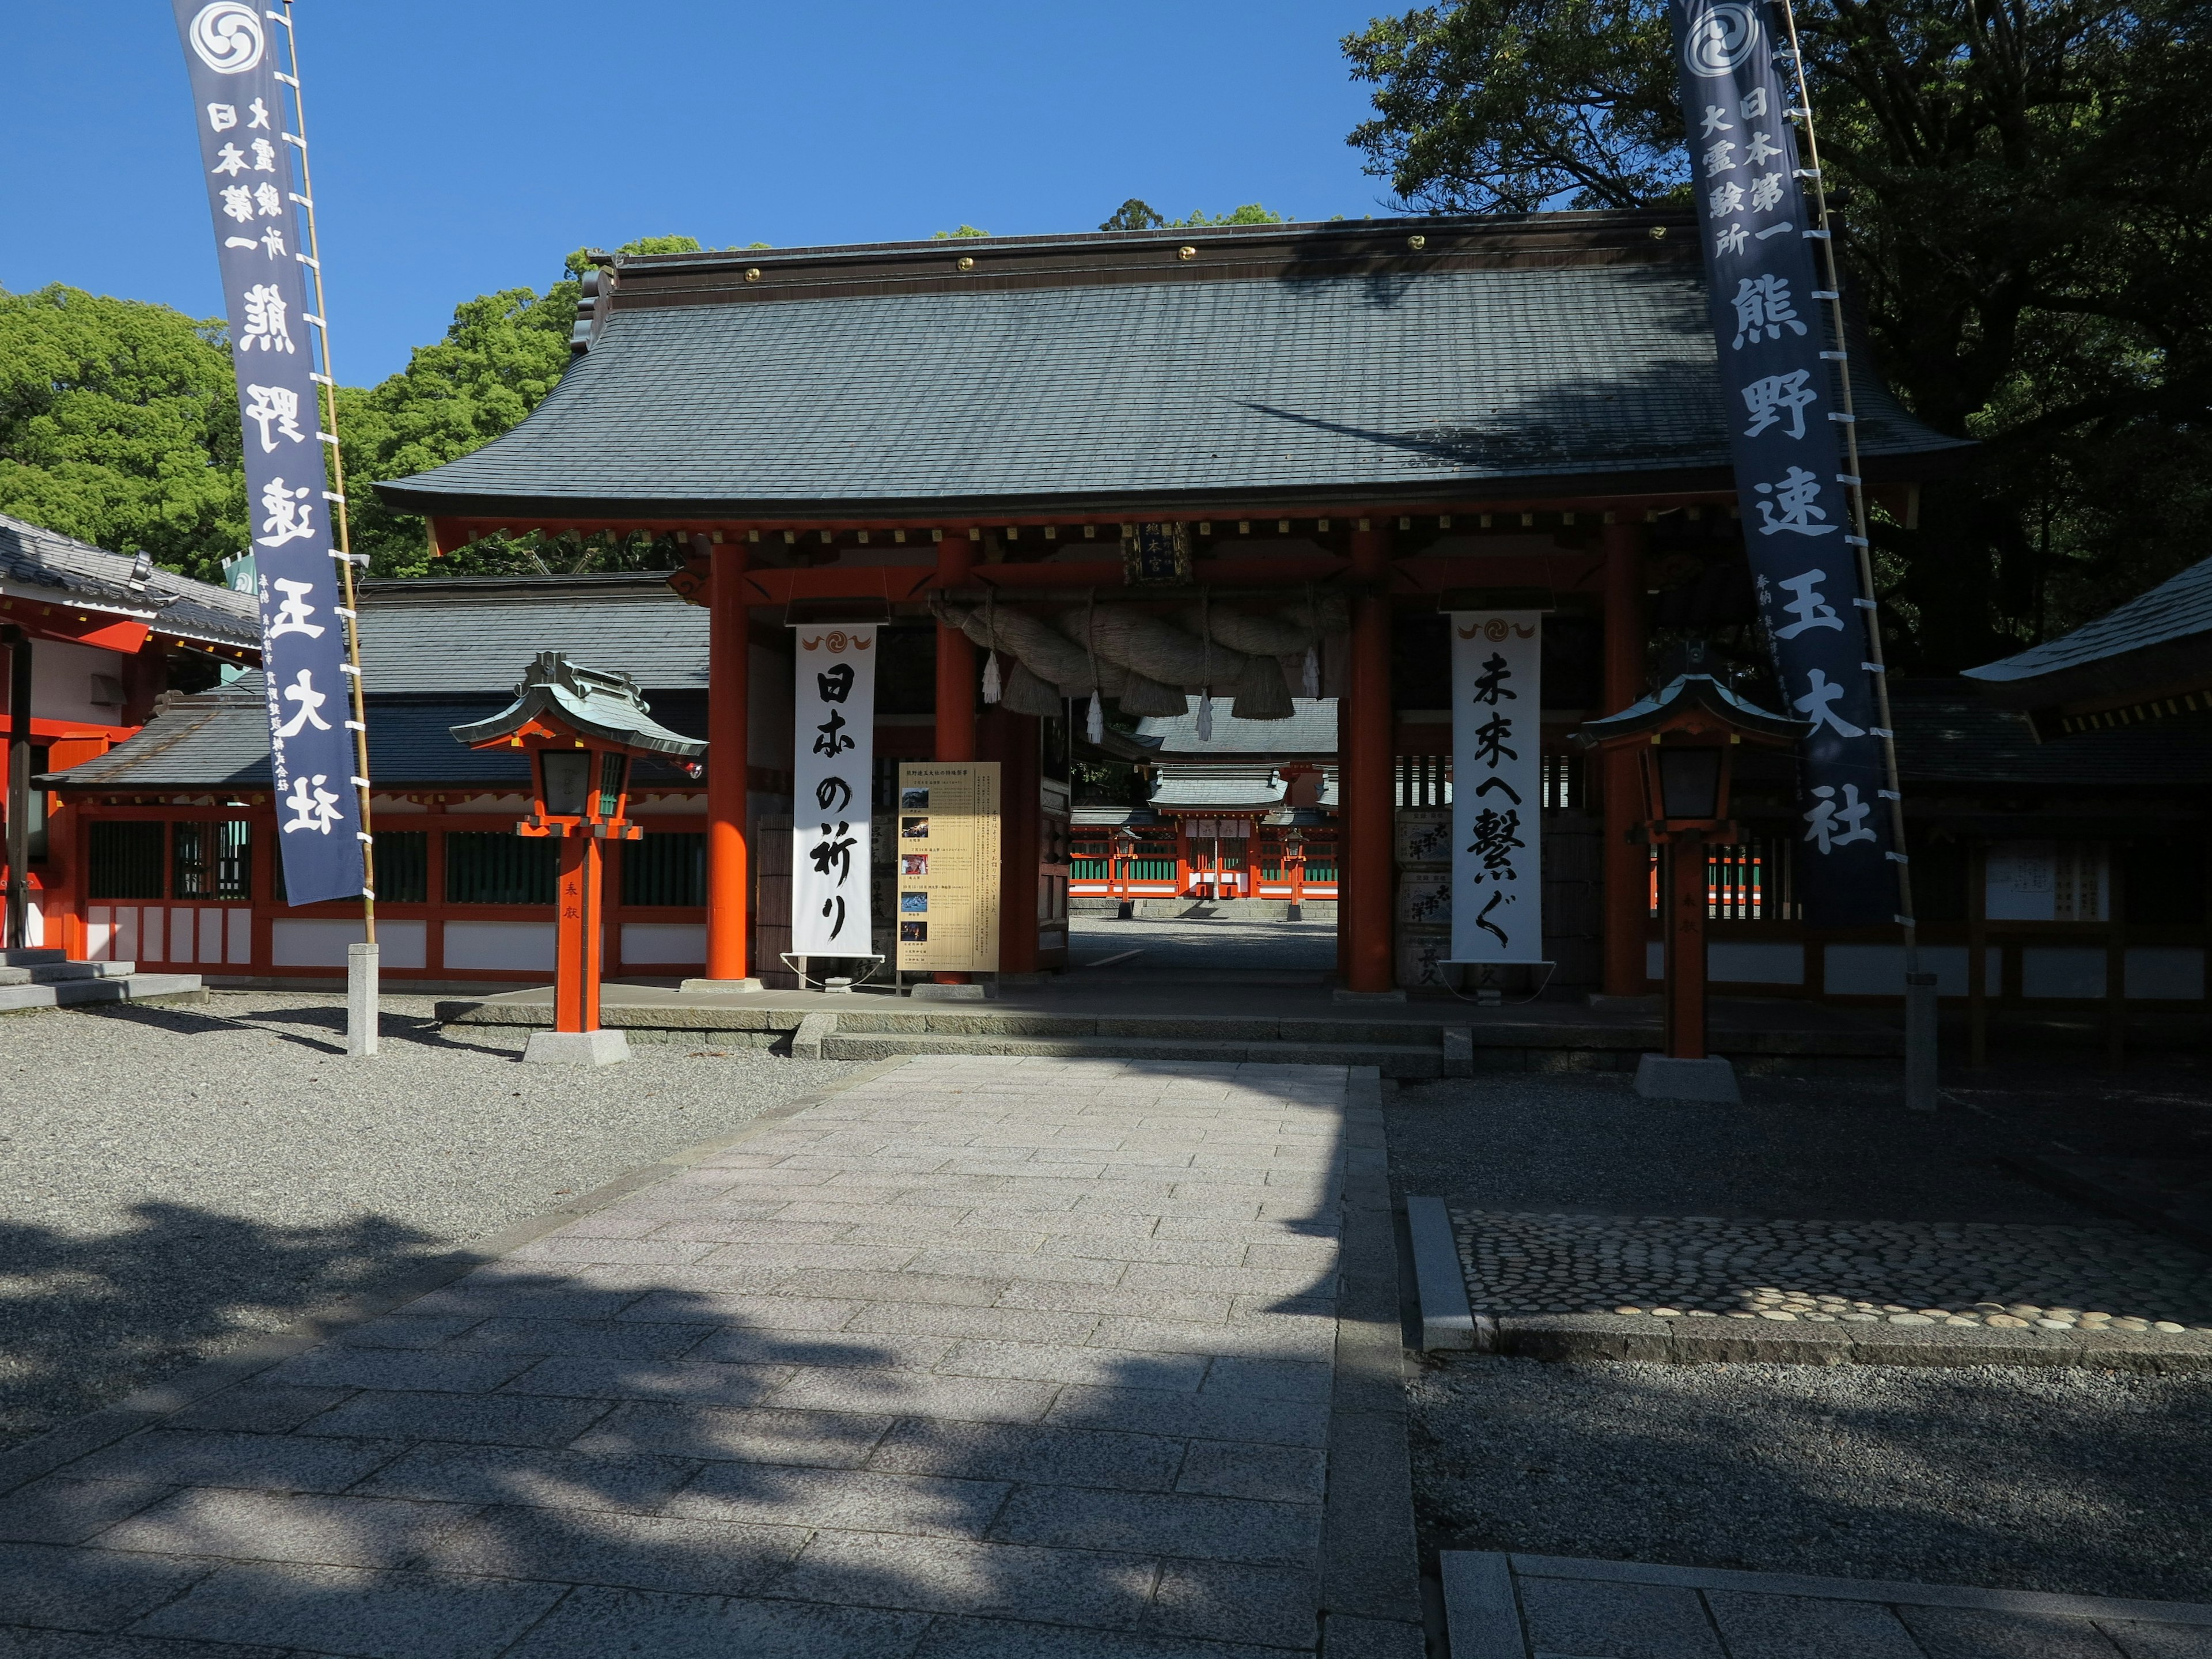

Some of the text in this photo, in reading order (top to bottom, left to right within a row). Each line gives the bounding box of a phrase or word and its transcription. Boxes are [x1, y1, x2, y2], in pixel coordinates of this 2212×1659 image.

[1700, 105, 1750, 259] 大霊験所
[1740, 86, 1794, 241] 日本第一
[1730, 273, 1877, 856] 熊野速玉大社
[809, 663, 857, 945] 日本の祈り
[1411, 884, 1451, 922] 太平洋
[1467, 652, 1526, 949] 未来へ繋ぐ
